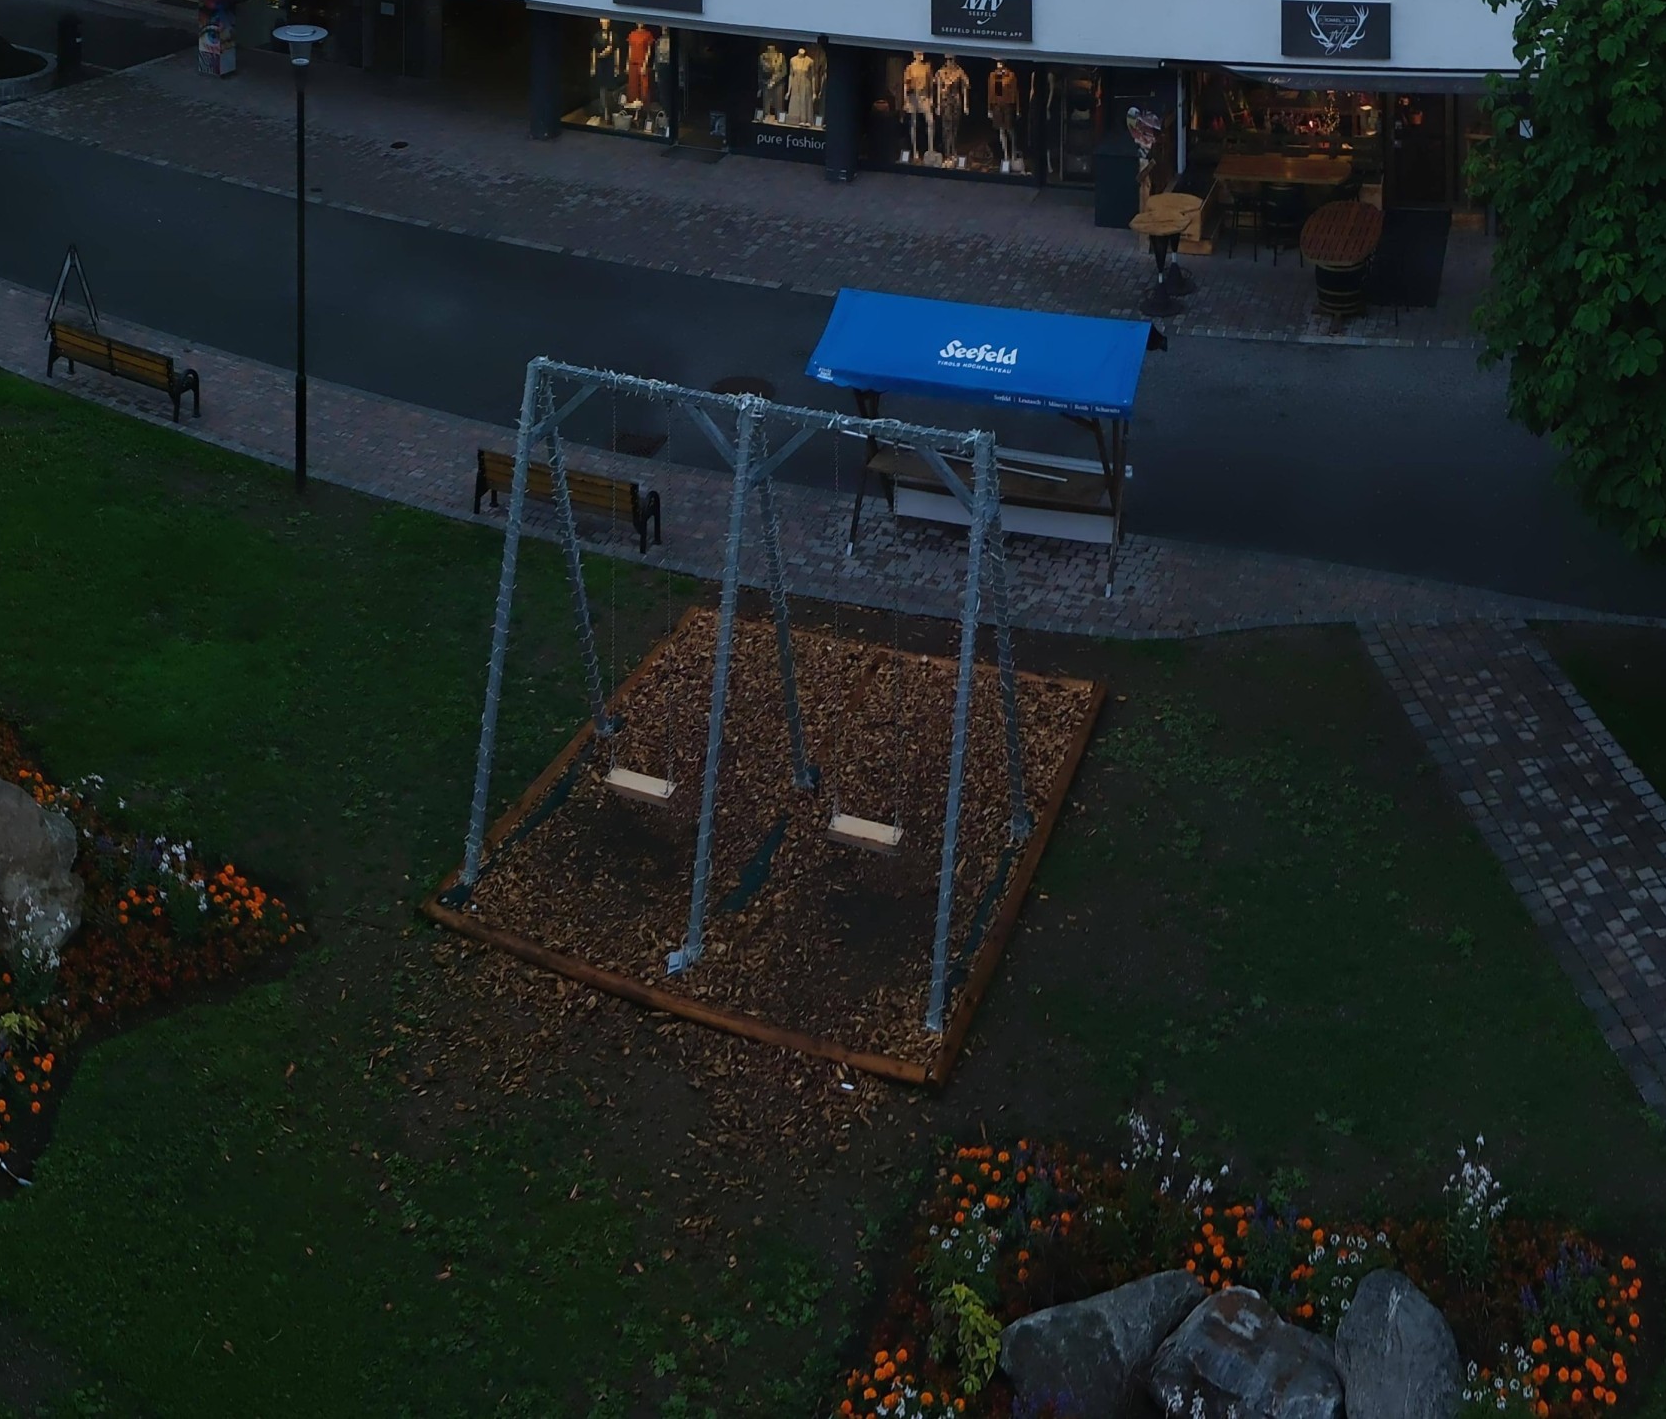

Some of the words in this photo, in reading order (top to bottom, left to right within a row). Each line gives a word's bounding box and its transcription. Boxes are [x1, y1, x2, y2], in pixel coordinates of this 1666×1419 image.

[941, 26, 969, 35] SEEFELD
[972, 29, 1008, 37] SHOPPING
[757, 133, 783, 145] pure
[940, 339, 1018, 366] Seefeld
[937, 360, 961, 369] TIROLS
[963, 363, 1012, 375] HOCHPLATEAU
